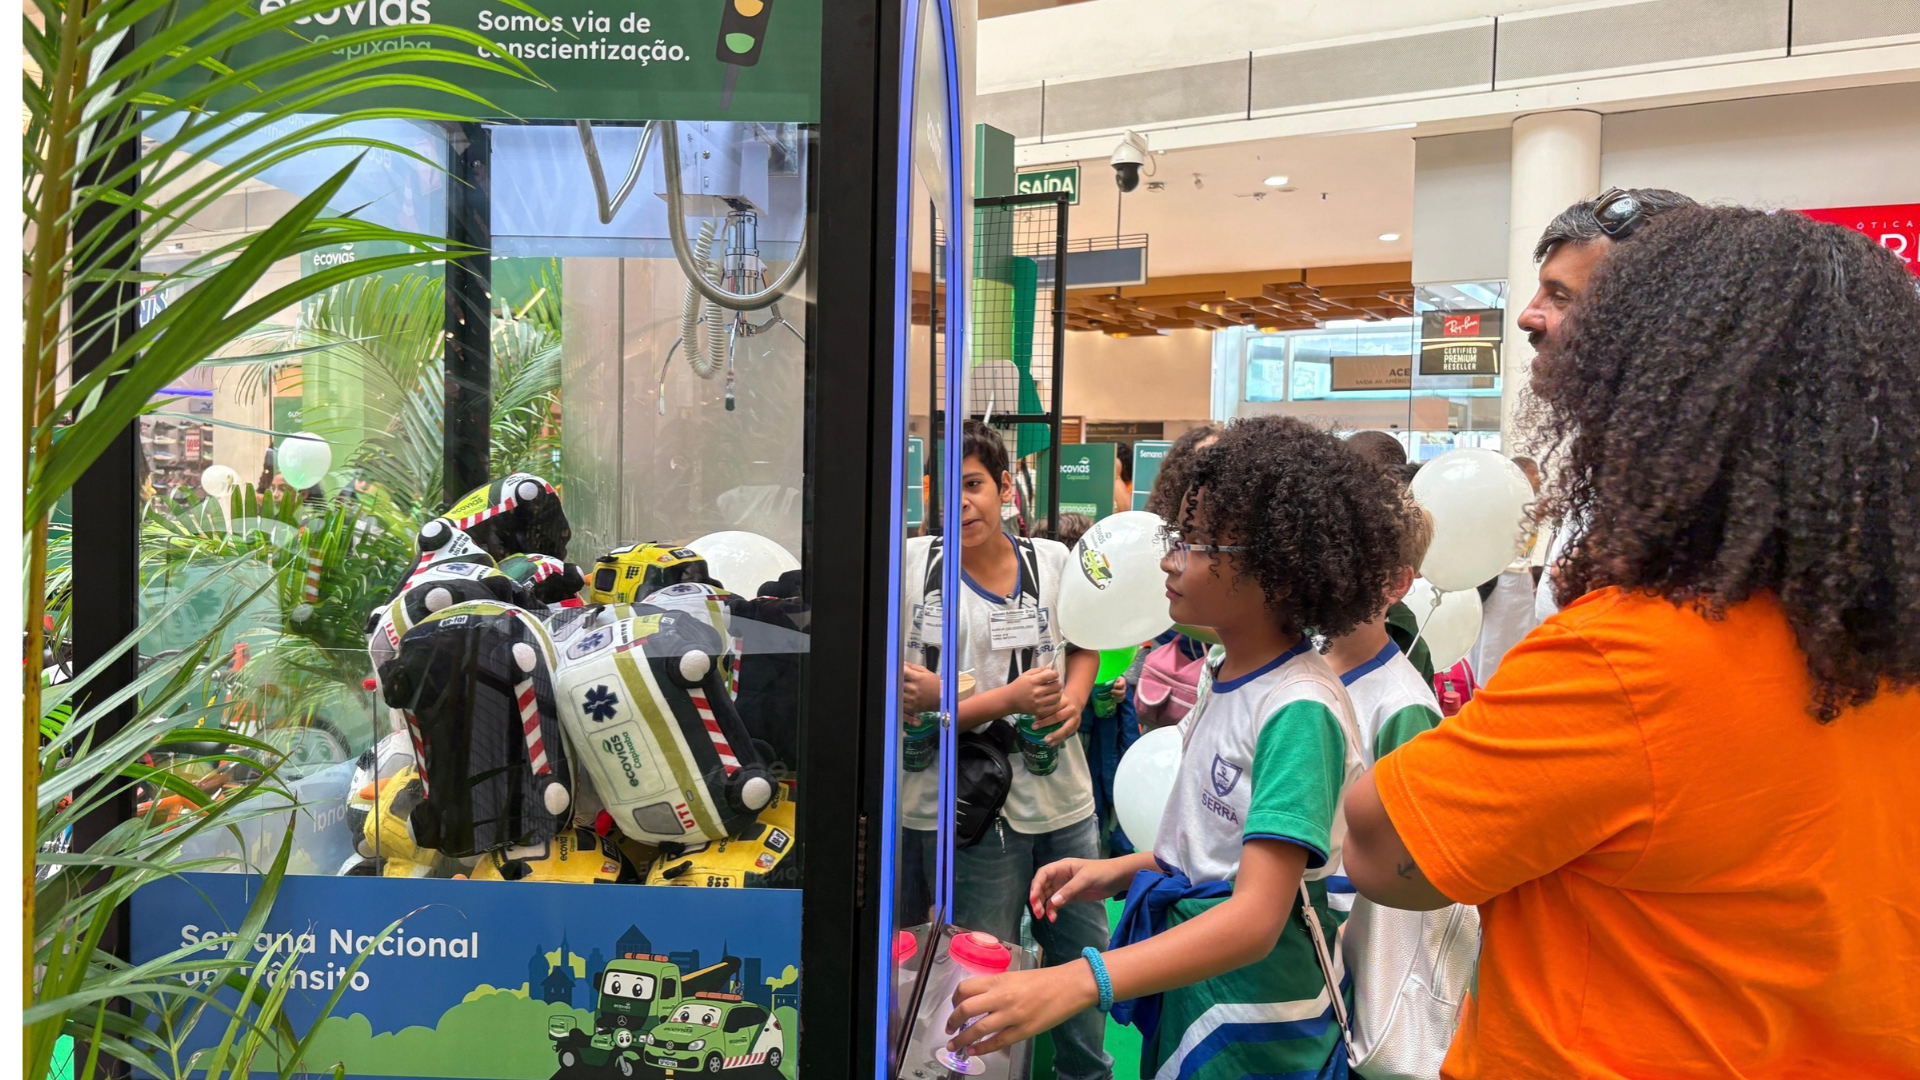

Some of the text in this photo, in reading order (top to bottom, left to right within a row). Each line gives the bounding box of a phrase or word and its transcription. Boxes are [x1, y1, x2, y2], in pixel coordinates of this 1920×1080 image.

[477, 10, 651, 34] Somos via de
[477, 38, 691, 67] conscientização.
[1019, 174, 1074, 195] SAÍDA
[1856, 220, 1920, 230] ÓTICA
[313, 249, 355, 266] ecovias
[1444, 347, 1477, 355] CERTIFIED
[1444, 355, 1477, 363] PREMIUM
[1389, 368, 1411, 377] ACE
[1139, 450, 1162, 458] Semana
[1059, 505, 1096, 514] gramação
[385, 622, 400, 646] UTI
[610, 734, 639, 787] ecovias
[622, 731, 642, 769] Capixaba
[675, 802, 695, 829] UTI
[1201, 793, 1239, 825] SERRA
[330, 928, 478, 958] Nacional
